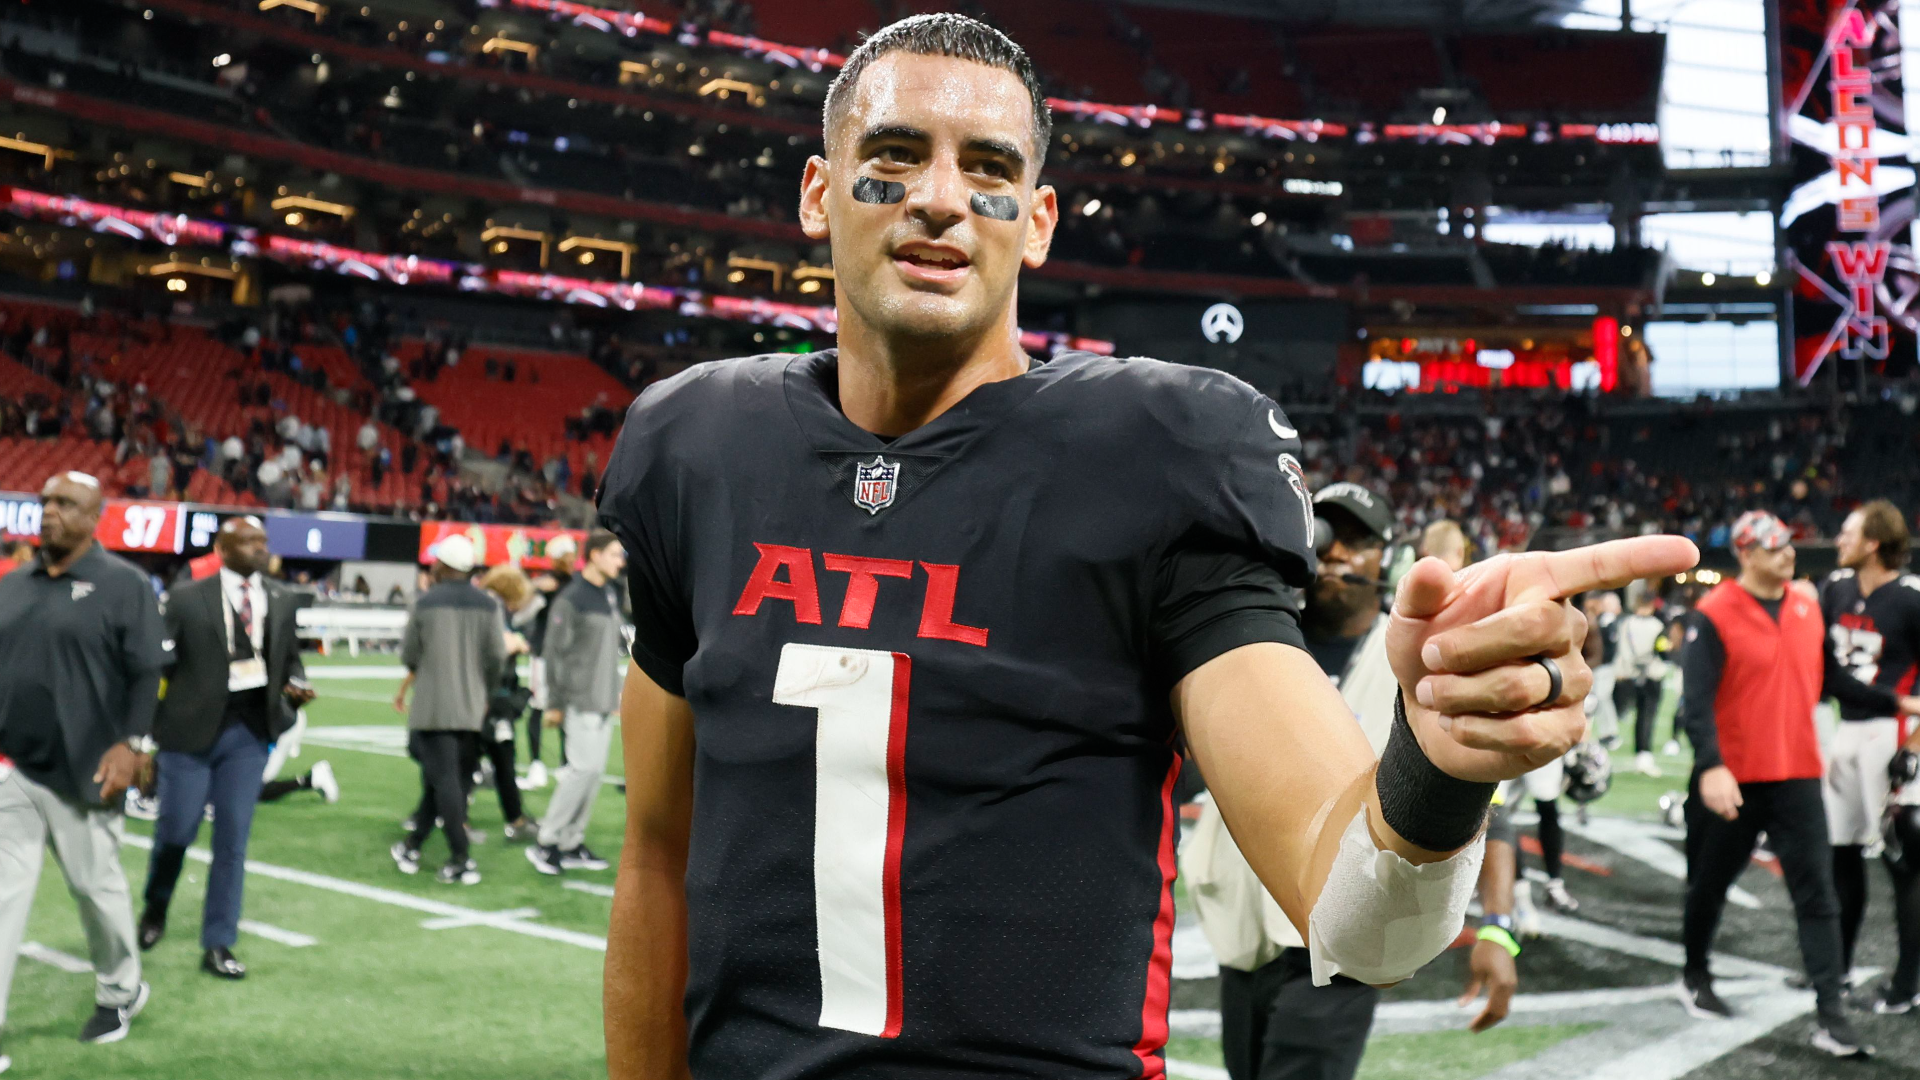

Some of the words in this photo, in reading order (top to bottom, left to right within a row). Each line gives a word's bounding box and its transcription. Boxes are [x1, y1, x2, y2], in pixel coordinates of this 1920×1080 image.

[1825, 241, 1892, 360] WIN
[122, 505, 166, 548] 37
[859, 481, 891, 503] NFL
[732, 542, 989, 647] ATL
[772, 642, 912, 1039] 1
